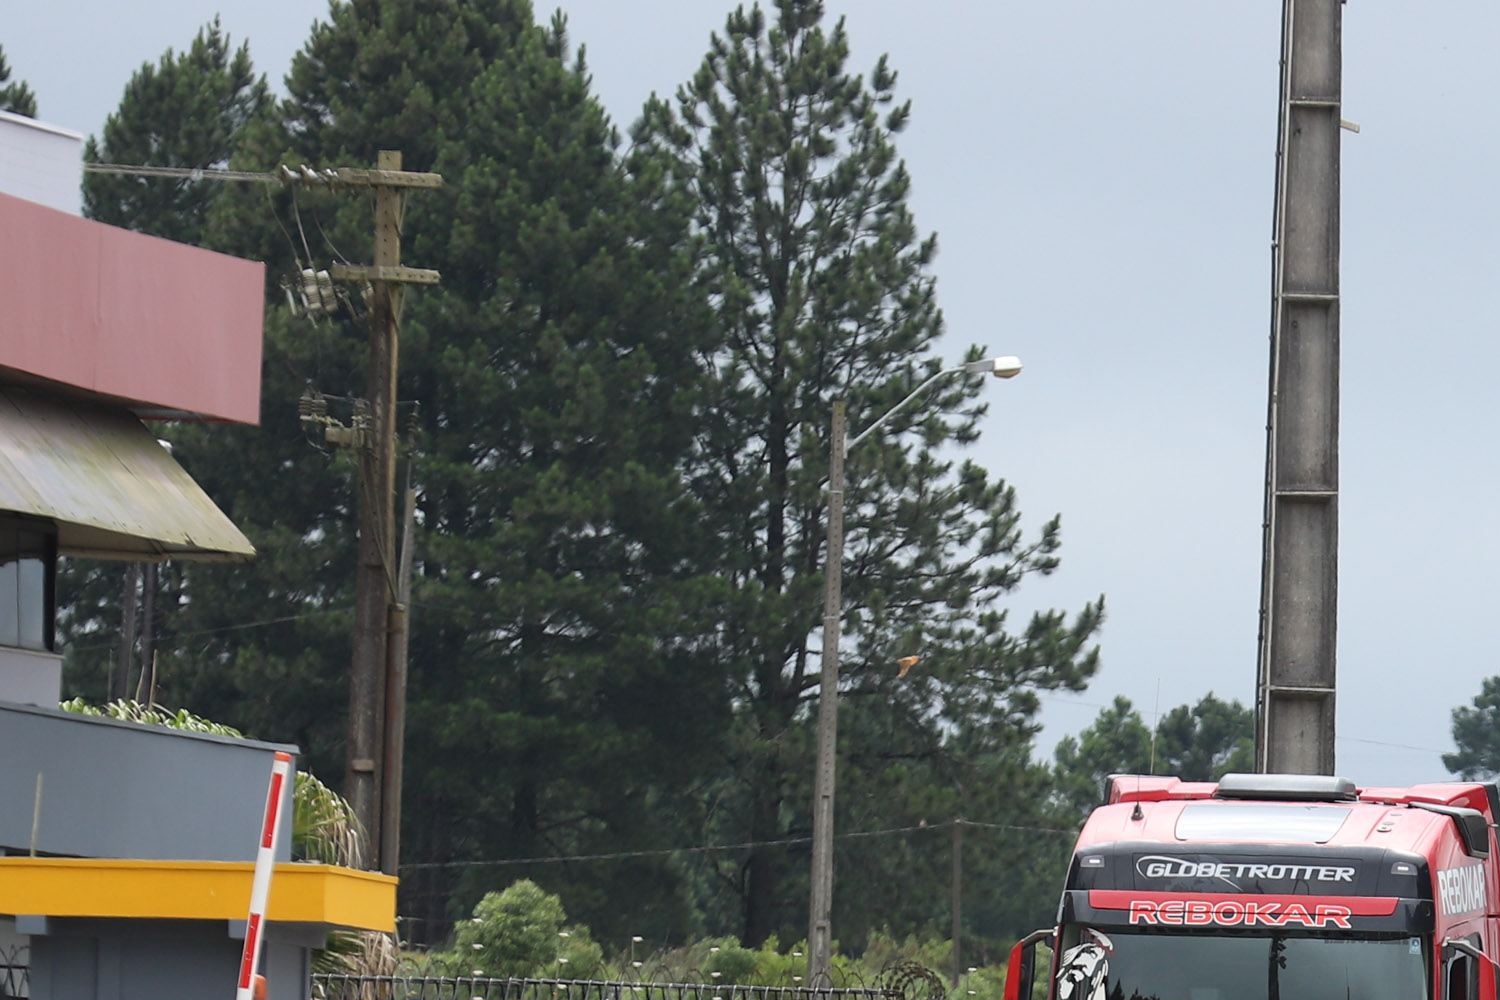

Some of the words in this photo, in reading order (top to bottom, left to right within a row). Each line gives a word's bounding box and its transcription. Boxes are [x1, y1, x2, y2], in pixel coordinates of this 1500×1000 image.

[1146, 862, 1355, 882] GLOBETROTTER
[1437, 863, 1487, 916] REBOKAR
[1129, 900, 1352, 929] REBOKAR
